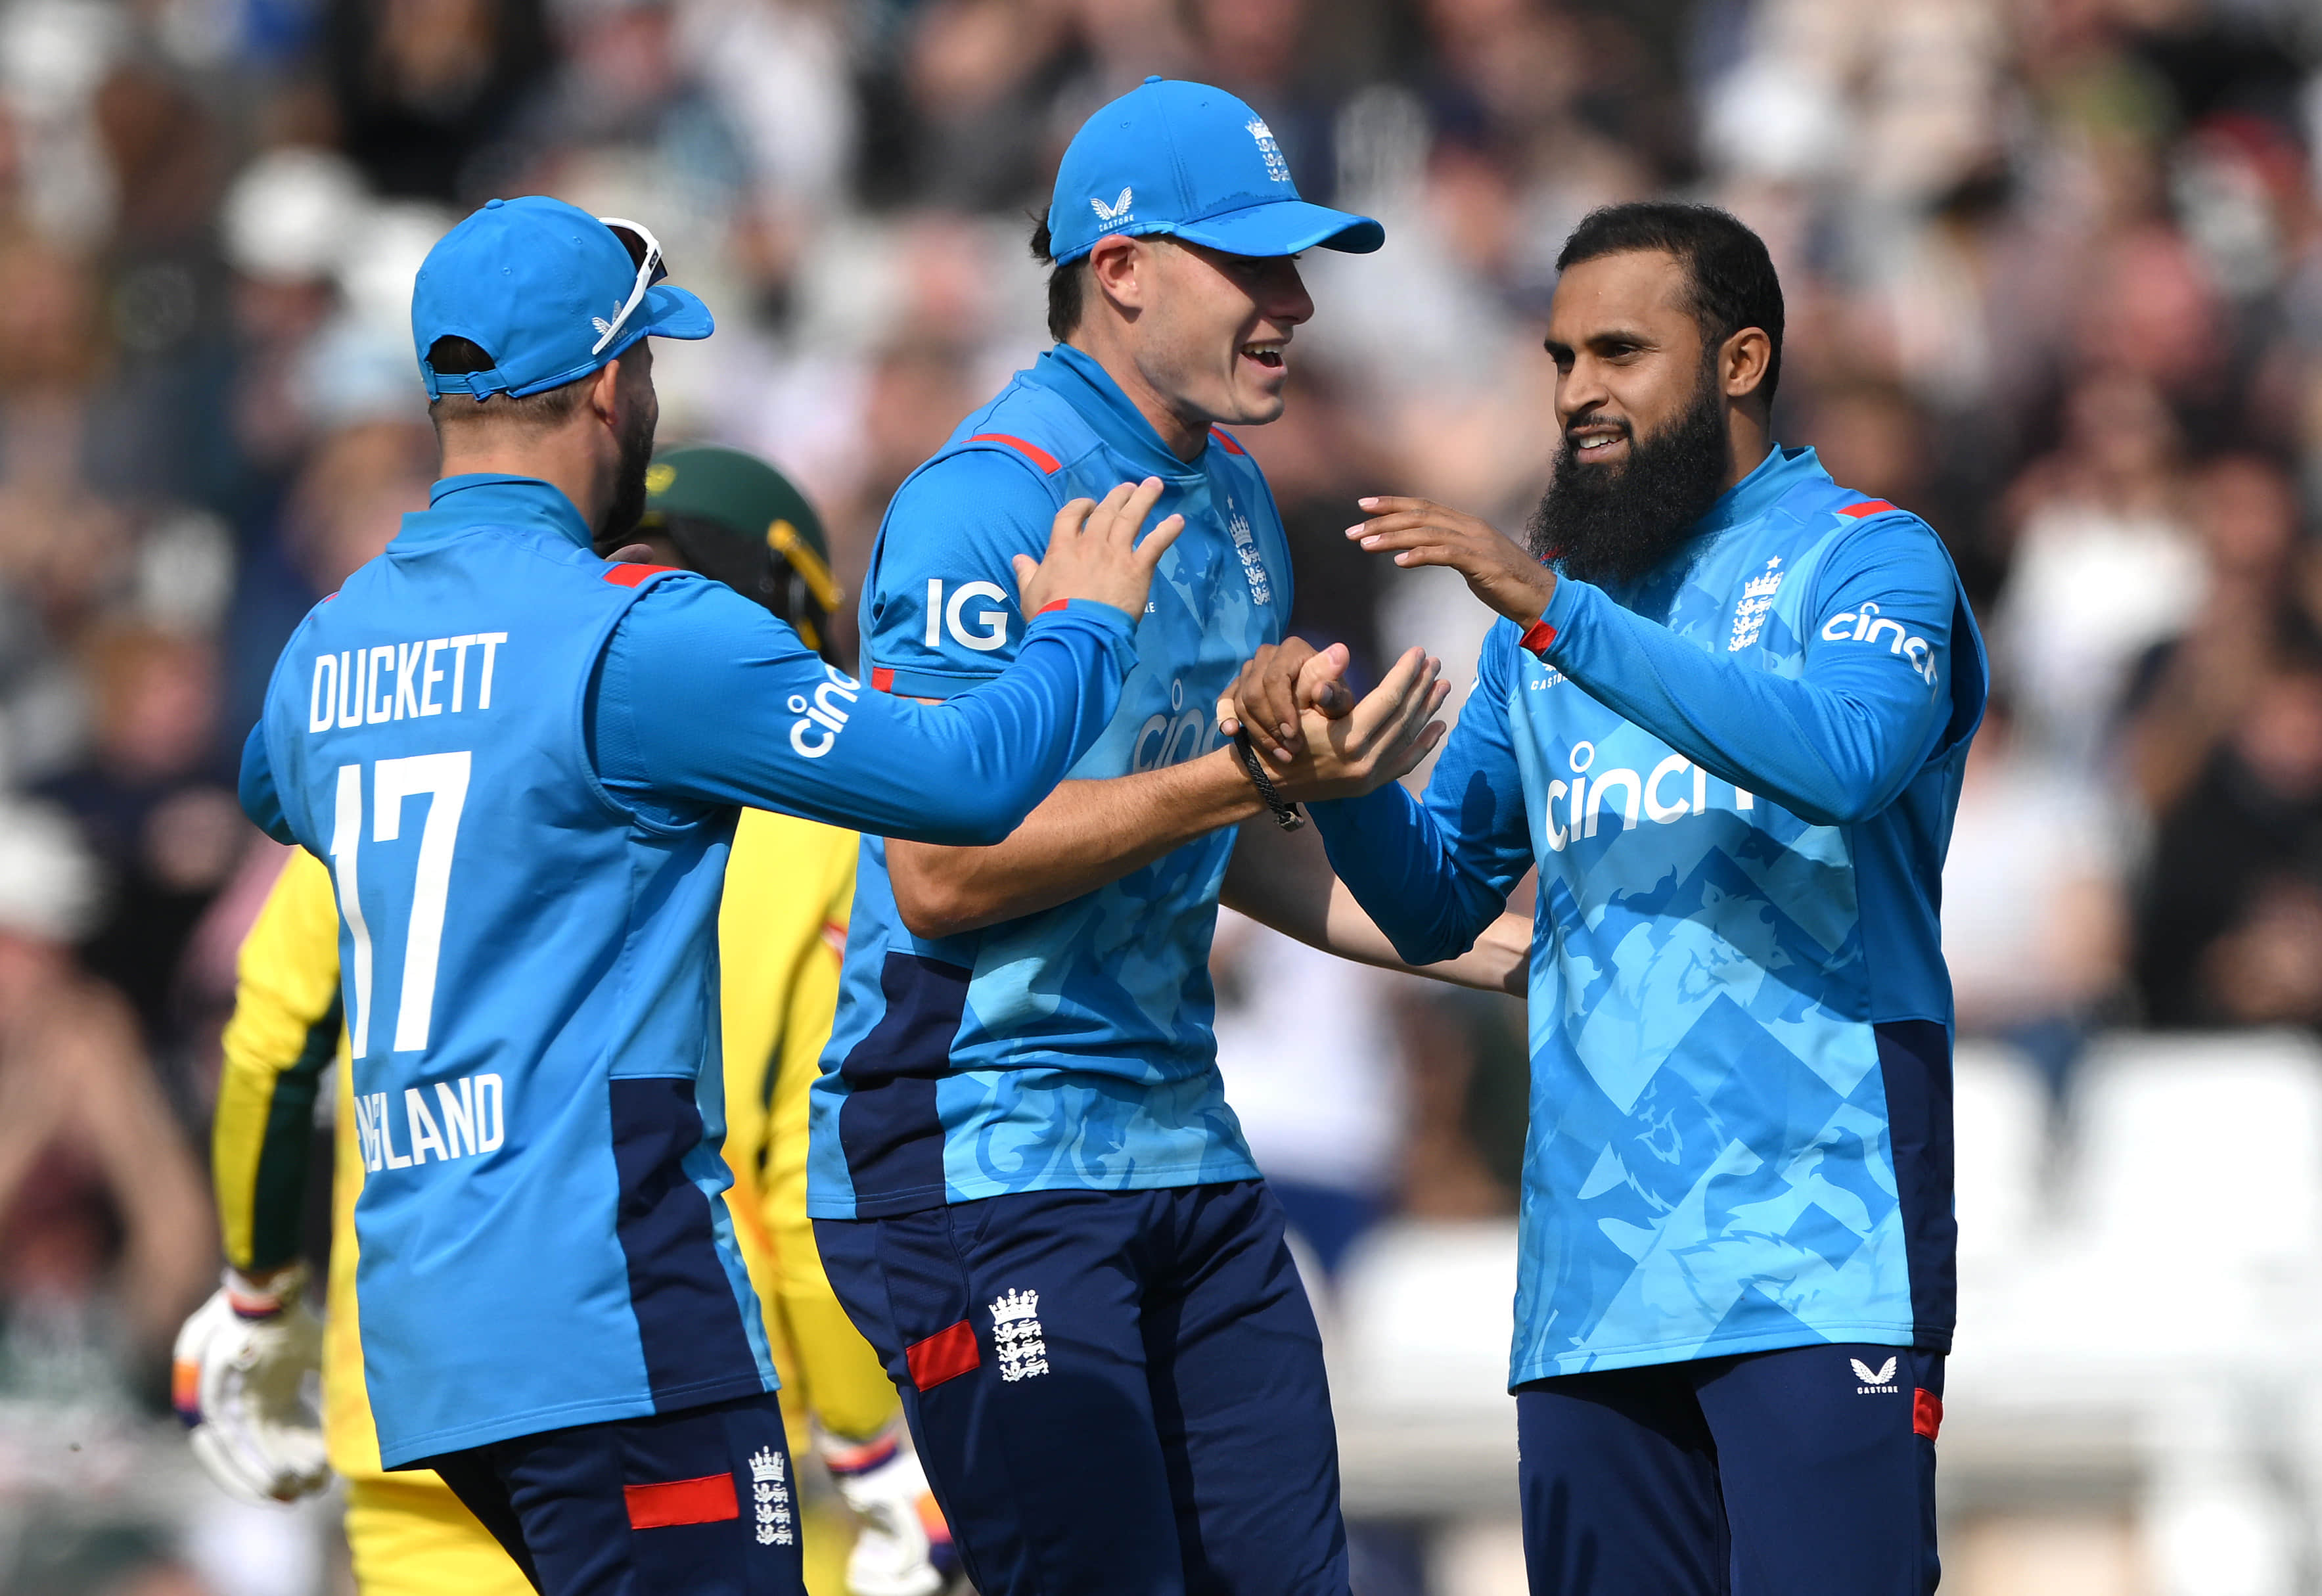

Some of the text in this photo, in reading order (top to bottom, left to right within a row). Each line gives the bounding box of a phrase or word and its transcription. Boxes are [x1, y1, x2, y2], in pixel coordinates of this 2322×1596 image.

[1099, 214, 1135, 233] CASTORE
[925, 578, 1009, 651] IG
[309, 631, 509, 733] DUCKETT
[329, 750, 472, 1059] 17
[353, 1073, 505, 1174] NGLAND
[1857, 1386, 1898, 1394] CASTORE
